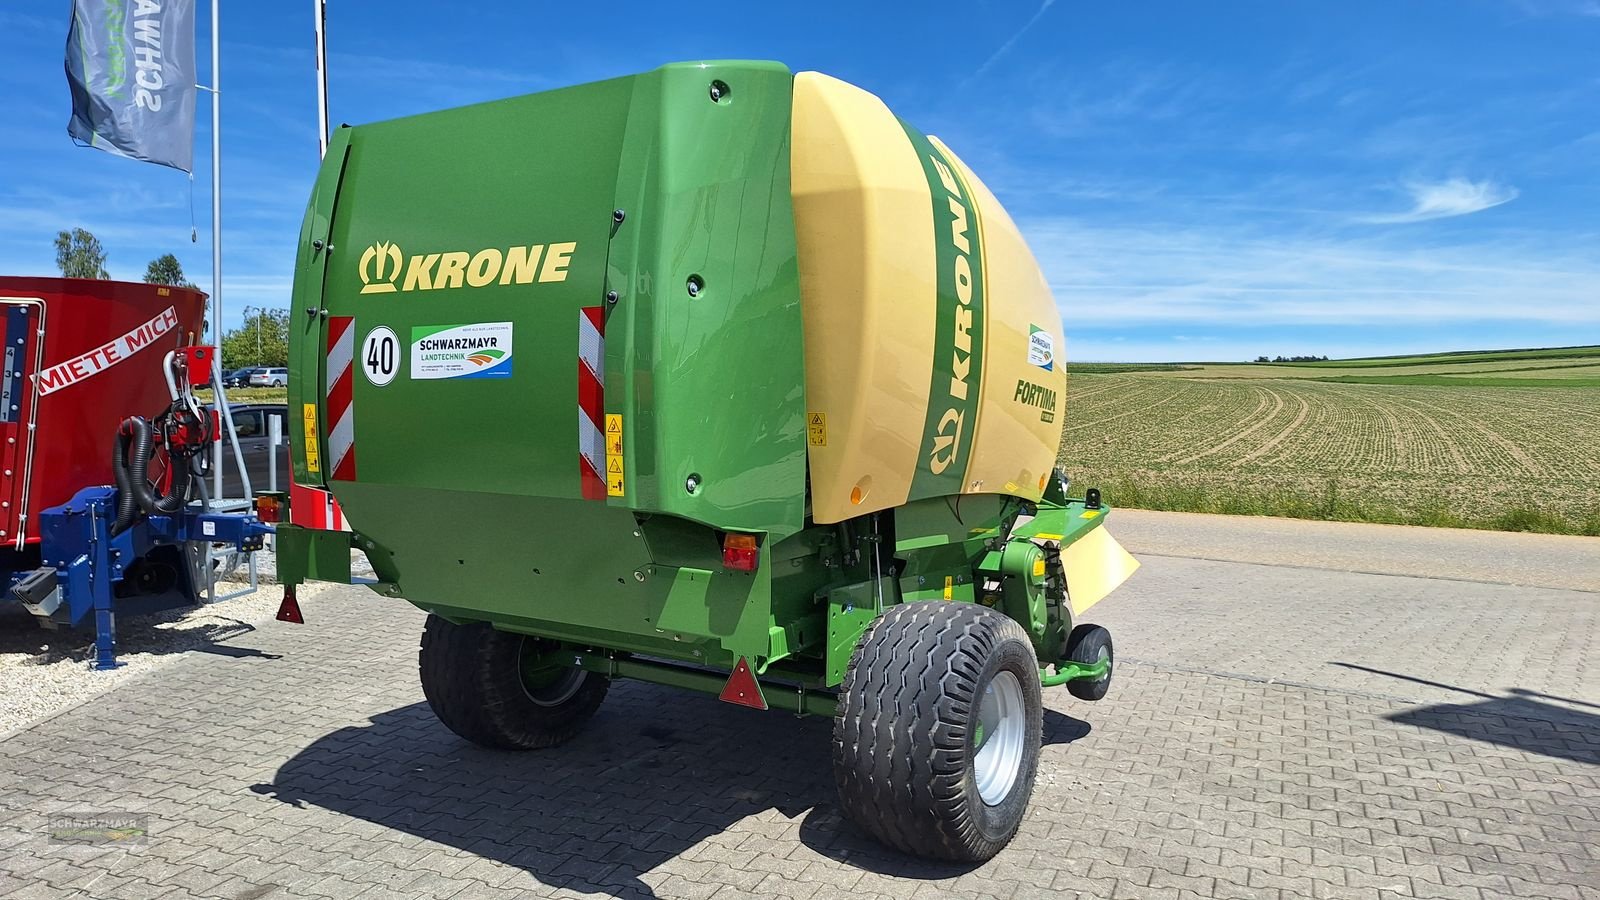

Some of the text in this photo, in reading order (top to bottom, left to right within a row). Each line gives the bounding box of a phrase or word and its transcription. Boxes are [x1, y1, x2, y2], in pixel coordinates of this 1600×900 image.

[402, 242, 577, 292] KRONE
[929, 154, 973, 401] KRONE
[420, 337, 498, 351] SCHWARZMAYR
[6, 348, 14, 357] 4
[38, 309, 178, 394] MIETE MICH
[367, 337, 394, 375] 40
[421, 352, 466, 361] LANDTECHNIK
[5, 370, 12, 378] 3
[3, 391, 10, 399] 2
[1014, 379, 1057, 412] FORTIMA
[2, 412, 7, 420] 1
